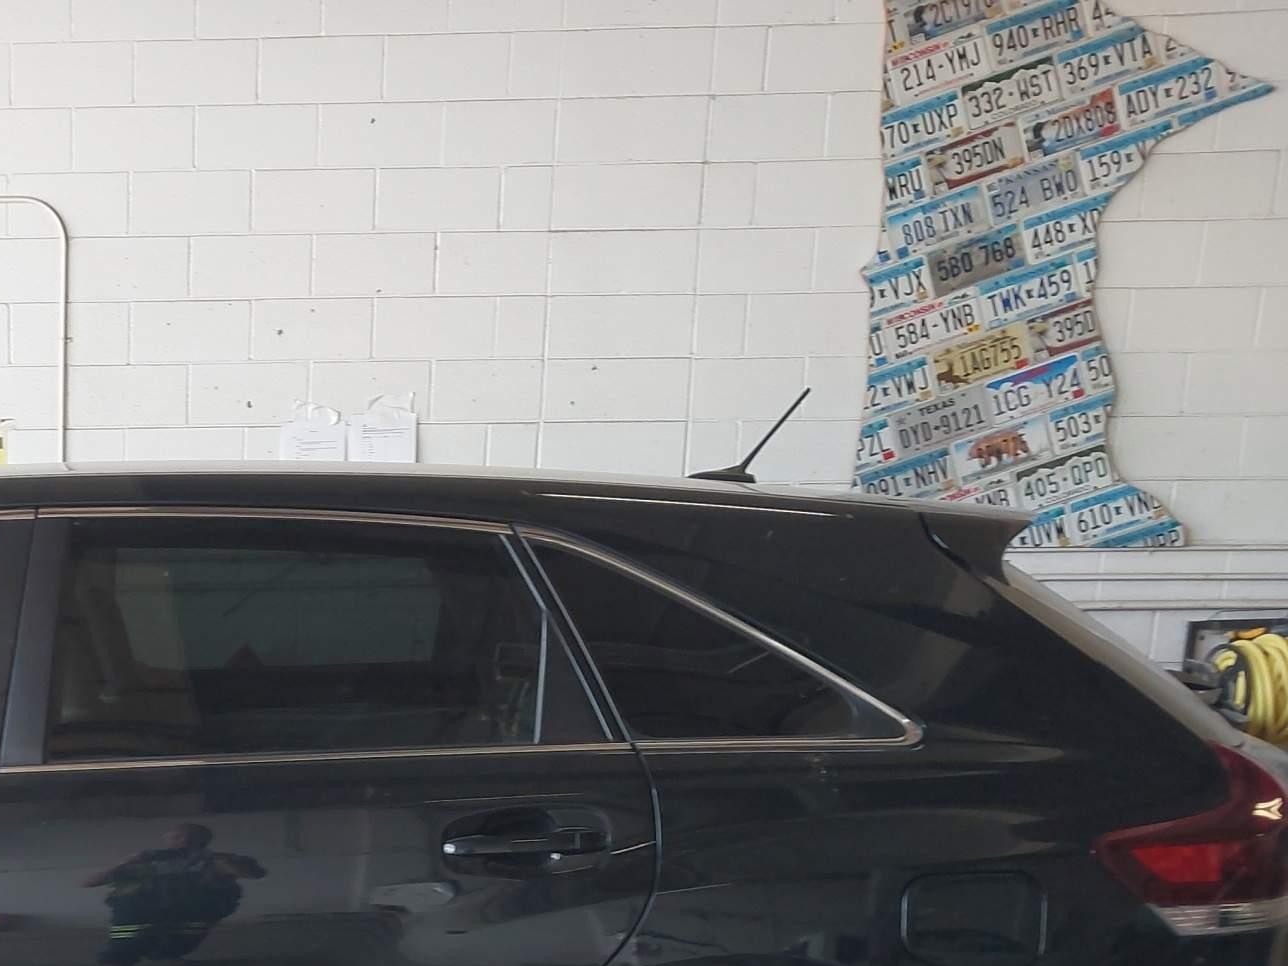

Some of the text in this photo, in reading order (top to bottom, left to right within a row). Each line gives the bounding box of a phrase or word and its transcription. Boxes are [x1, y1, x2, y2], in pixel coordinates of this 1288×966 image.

[1063, 52, 1100, 86] 369
[1175, 67, 1215, 101] 232
[1087, 150, 1123, 182] 159
[991, 185, 1030, 218] 524
[1031, 220, 1066, 251] 448
[1038, 269, 1073, 301] 459
[918, 397, 956, 417] TEXAS
[1054, 411, 1093, 443] 503
[1076, 503, 1113, 534] 610
